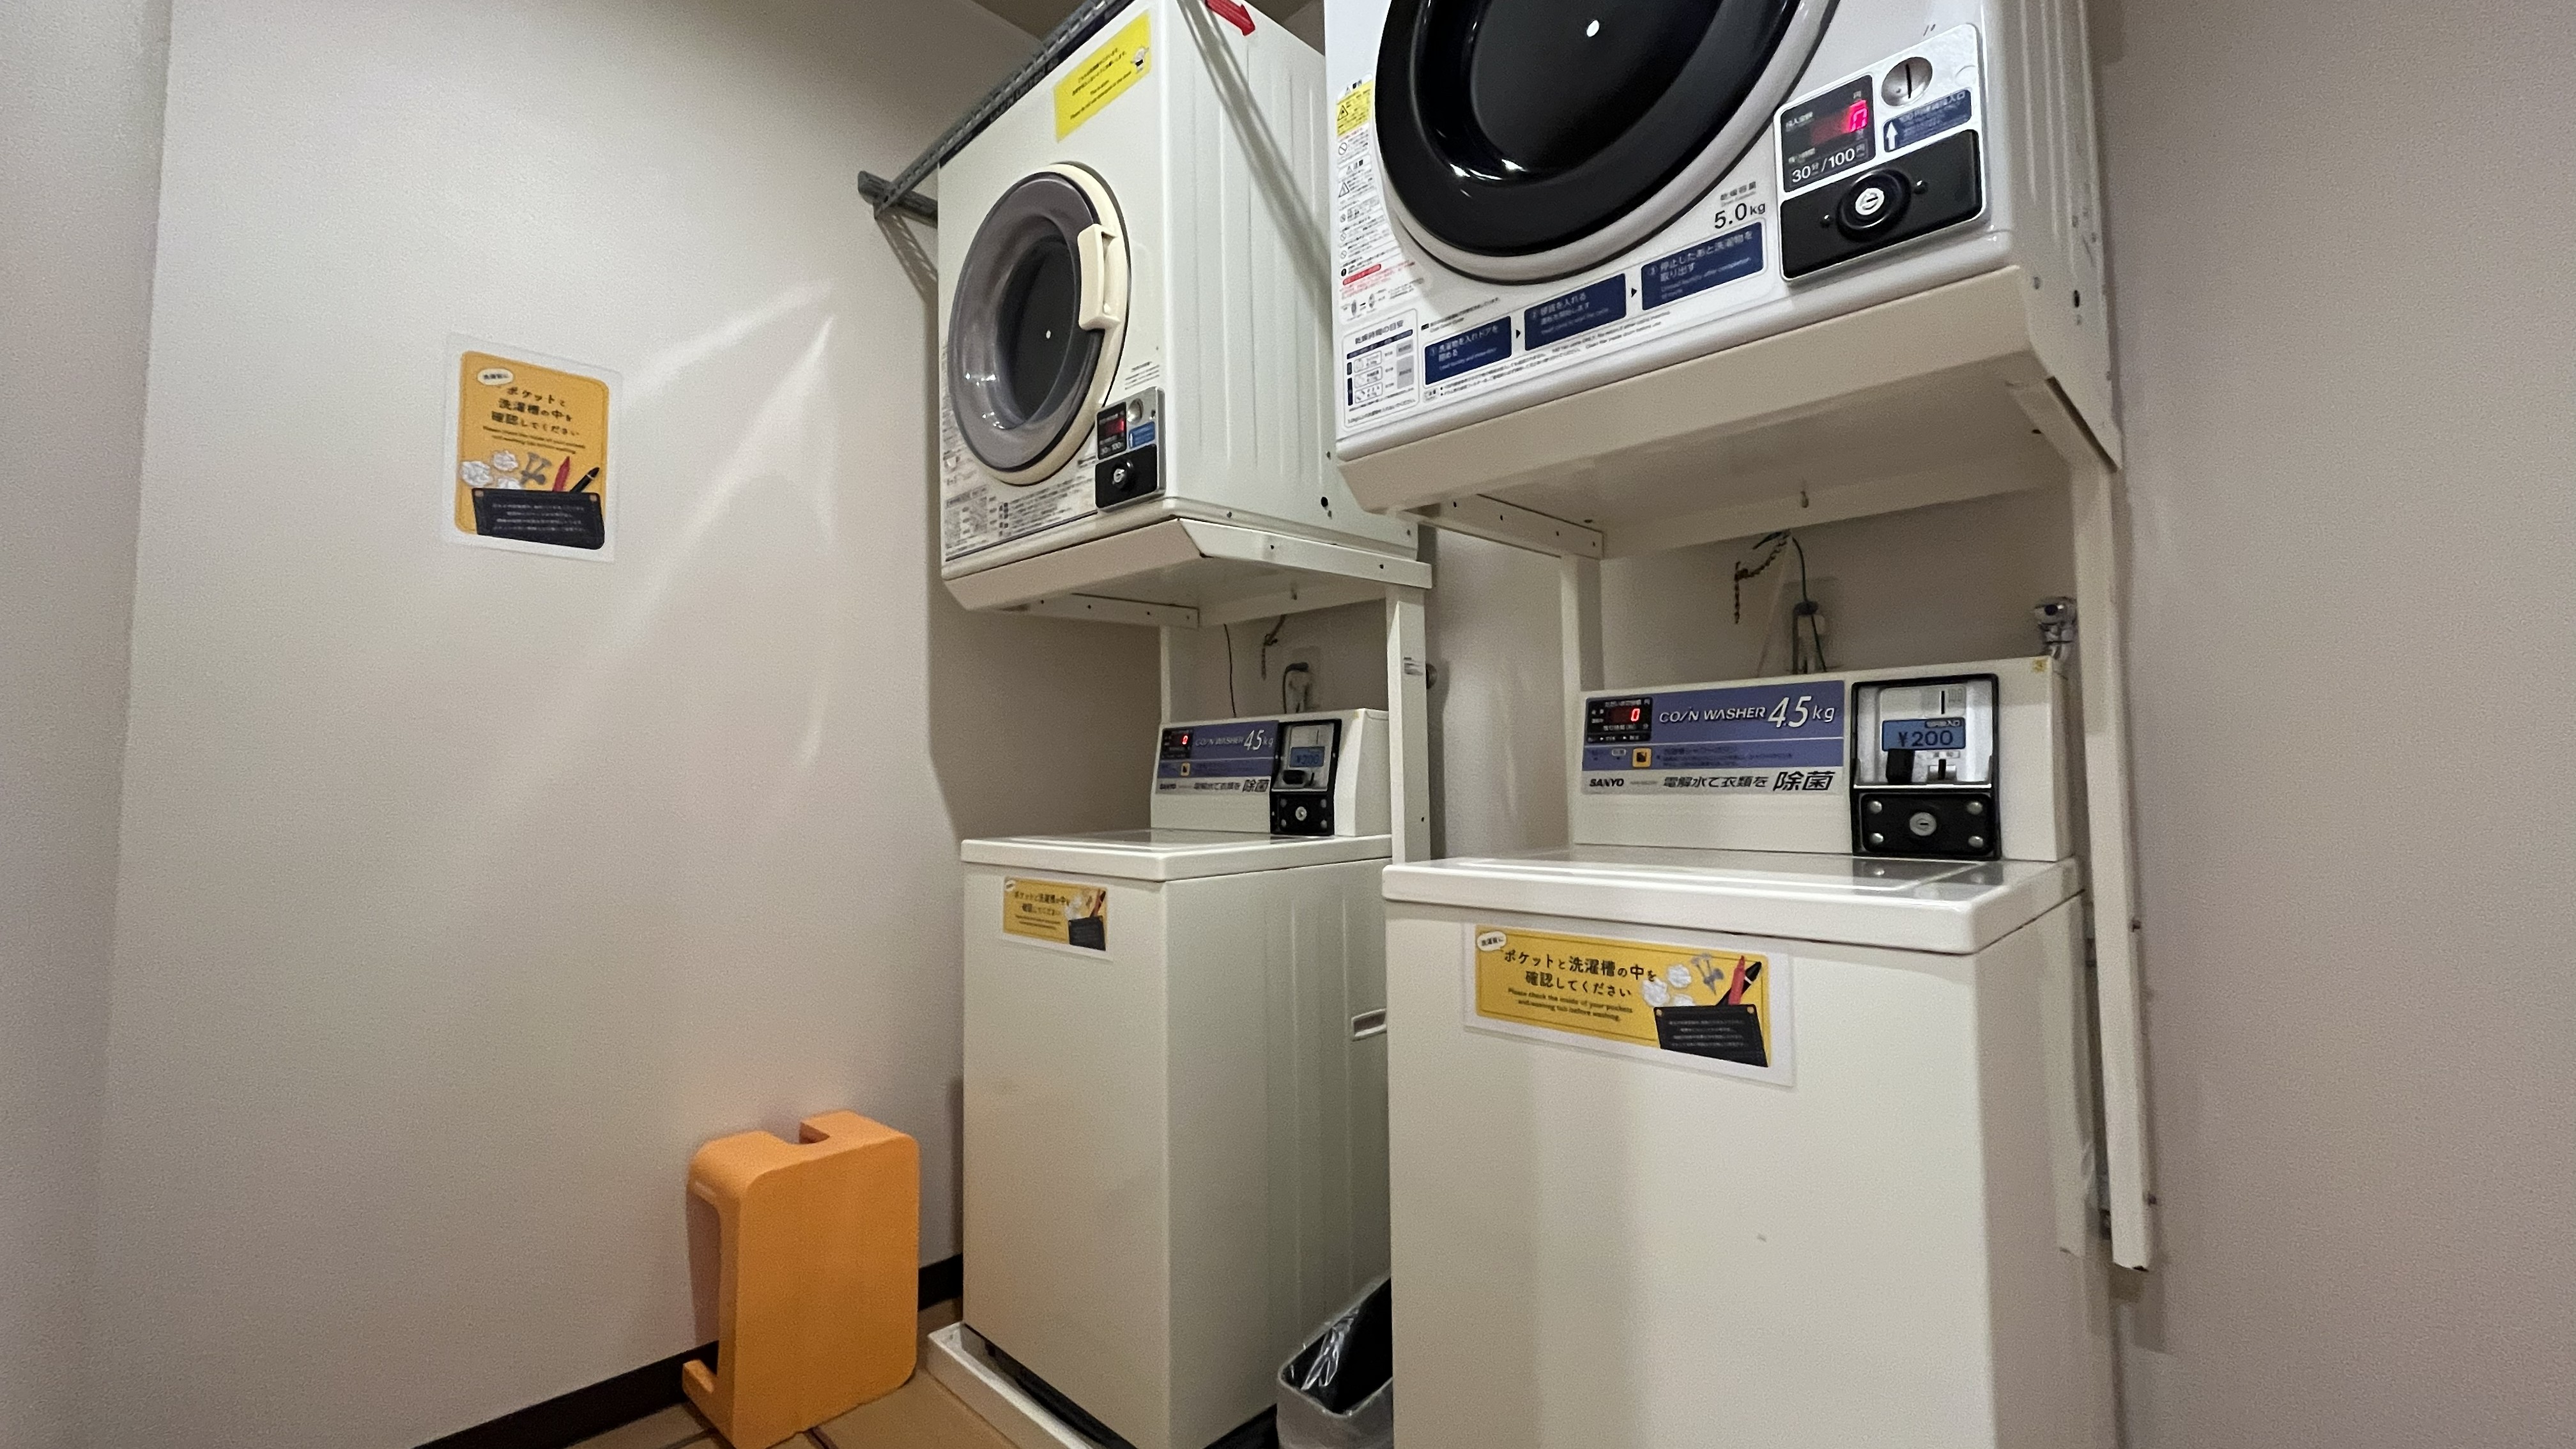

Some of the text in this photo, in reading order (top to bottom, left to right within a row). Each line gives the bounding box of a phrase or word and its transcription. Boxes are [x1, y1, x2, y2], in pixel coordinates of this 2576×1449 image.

[1630, 708, 1641, 722] 0
[1703, 706, 1766, 720] WASHER
[1897, 730, 1953, 747] ¥200
[1589, 778, 1625, 787] SANYO
[1504, 949, 1657, 982] ポケットと洗濯槽の中を
[1525, 970, 1632, 997] 確認してください
